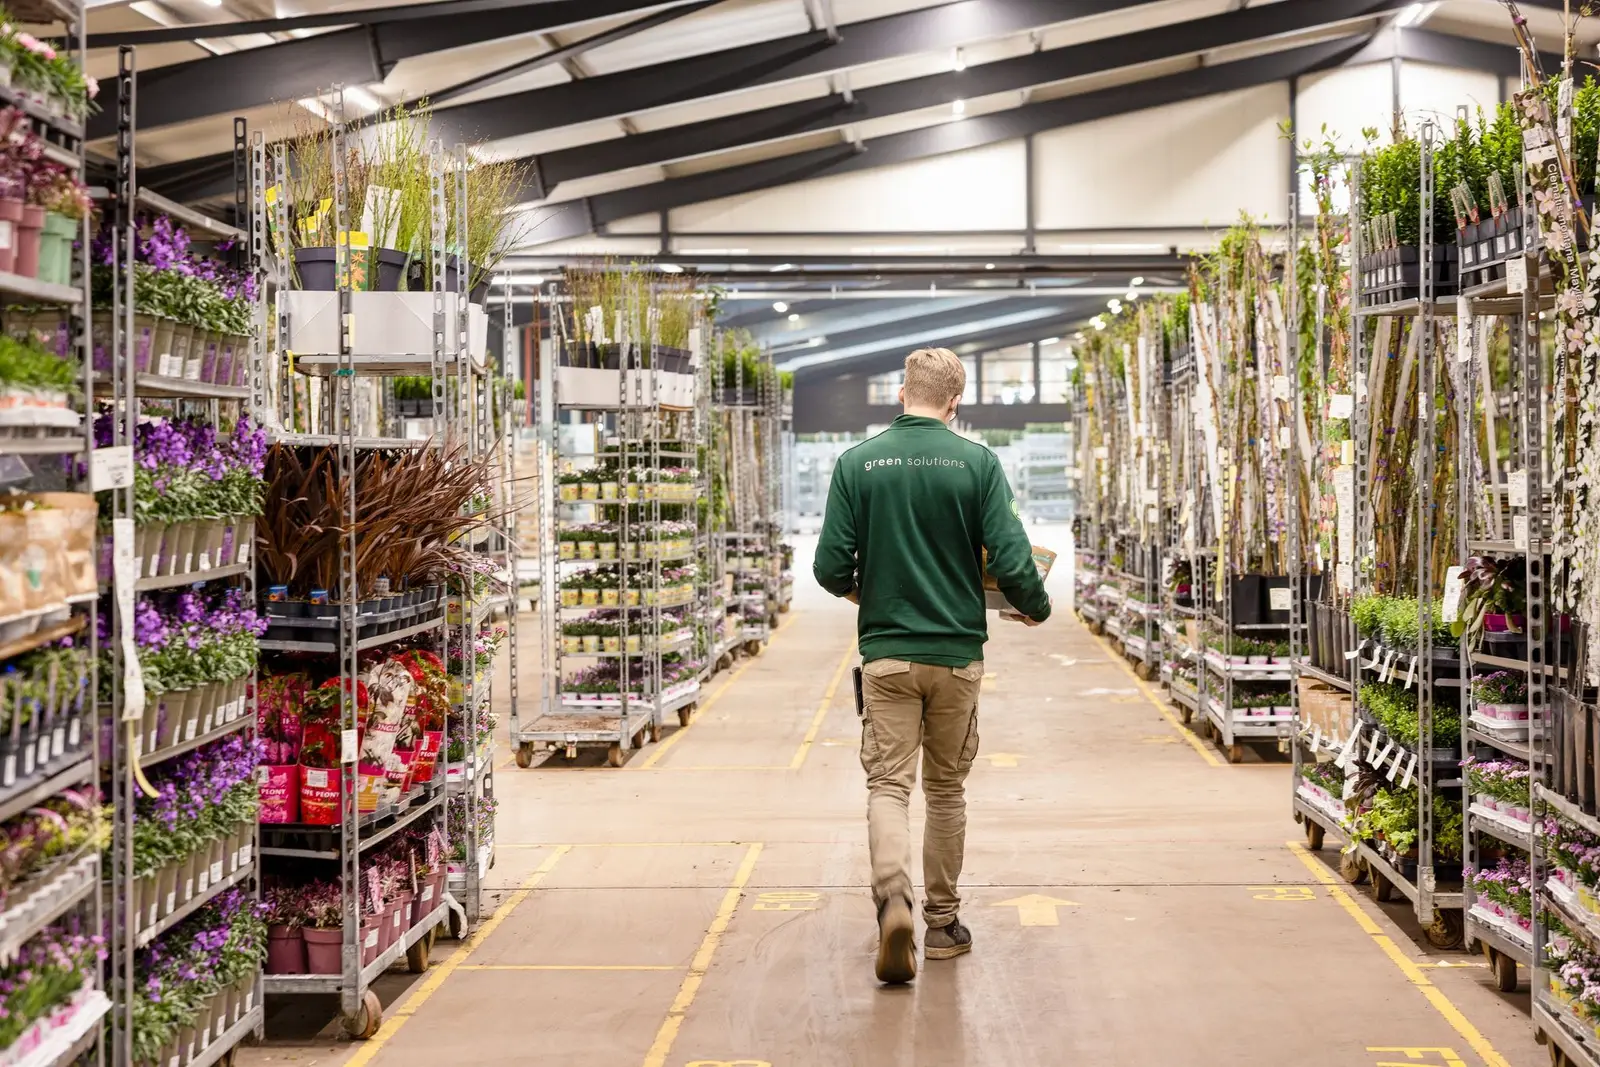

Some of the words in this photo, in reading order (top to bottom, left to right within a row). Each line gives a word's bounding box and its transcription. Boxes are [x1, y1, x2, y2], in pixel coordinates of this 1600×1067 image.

[1547, 163, 1565, 215] Clematis
[1558, 215, 1575, 263] montana
[864, 457, 902, 471] green
[907, 456, 965, 469] solutions
[315, 790, 340, 798] PEONY
